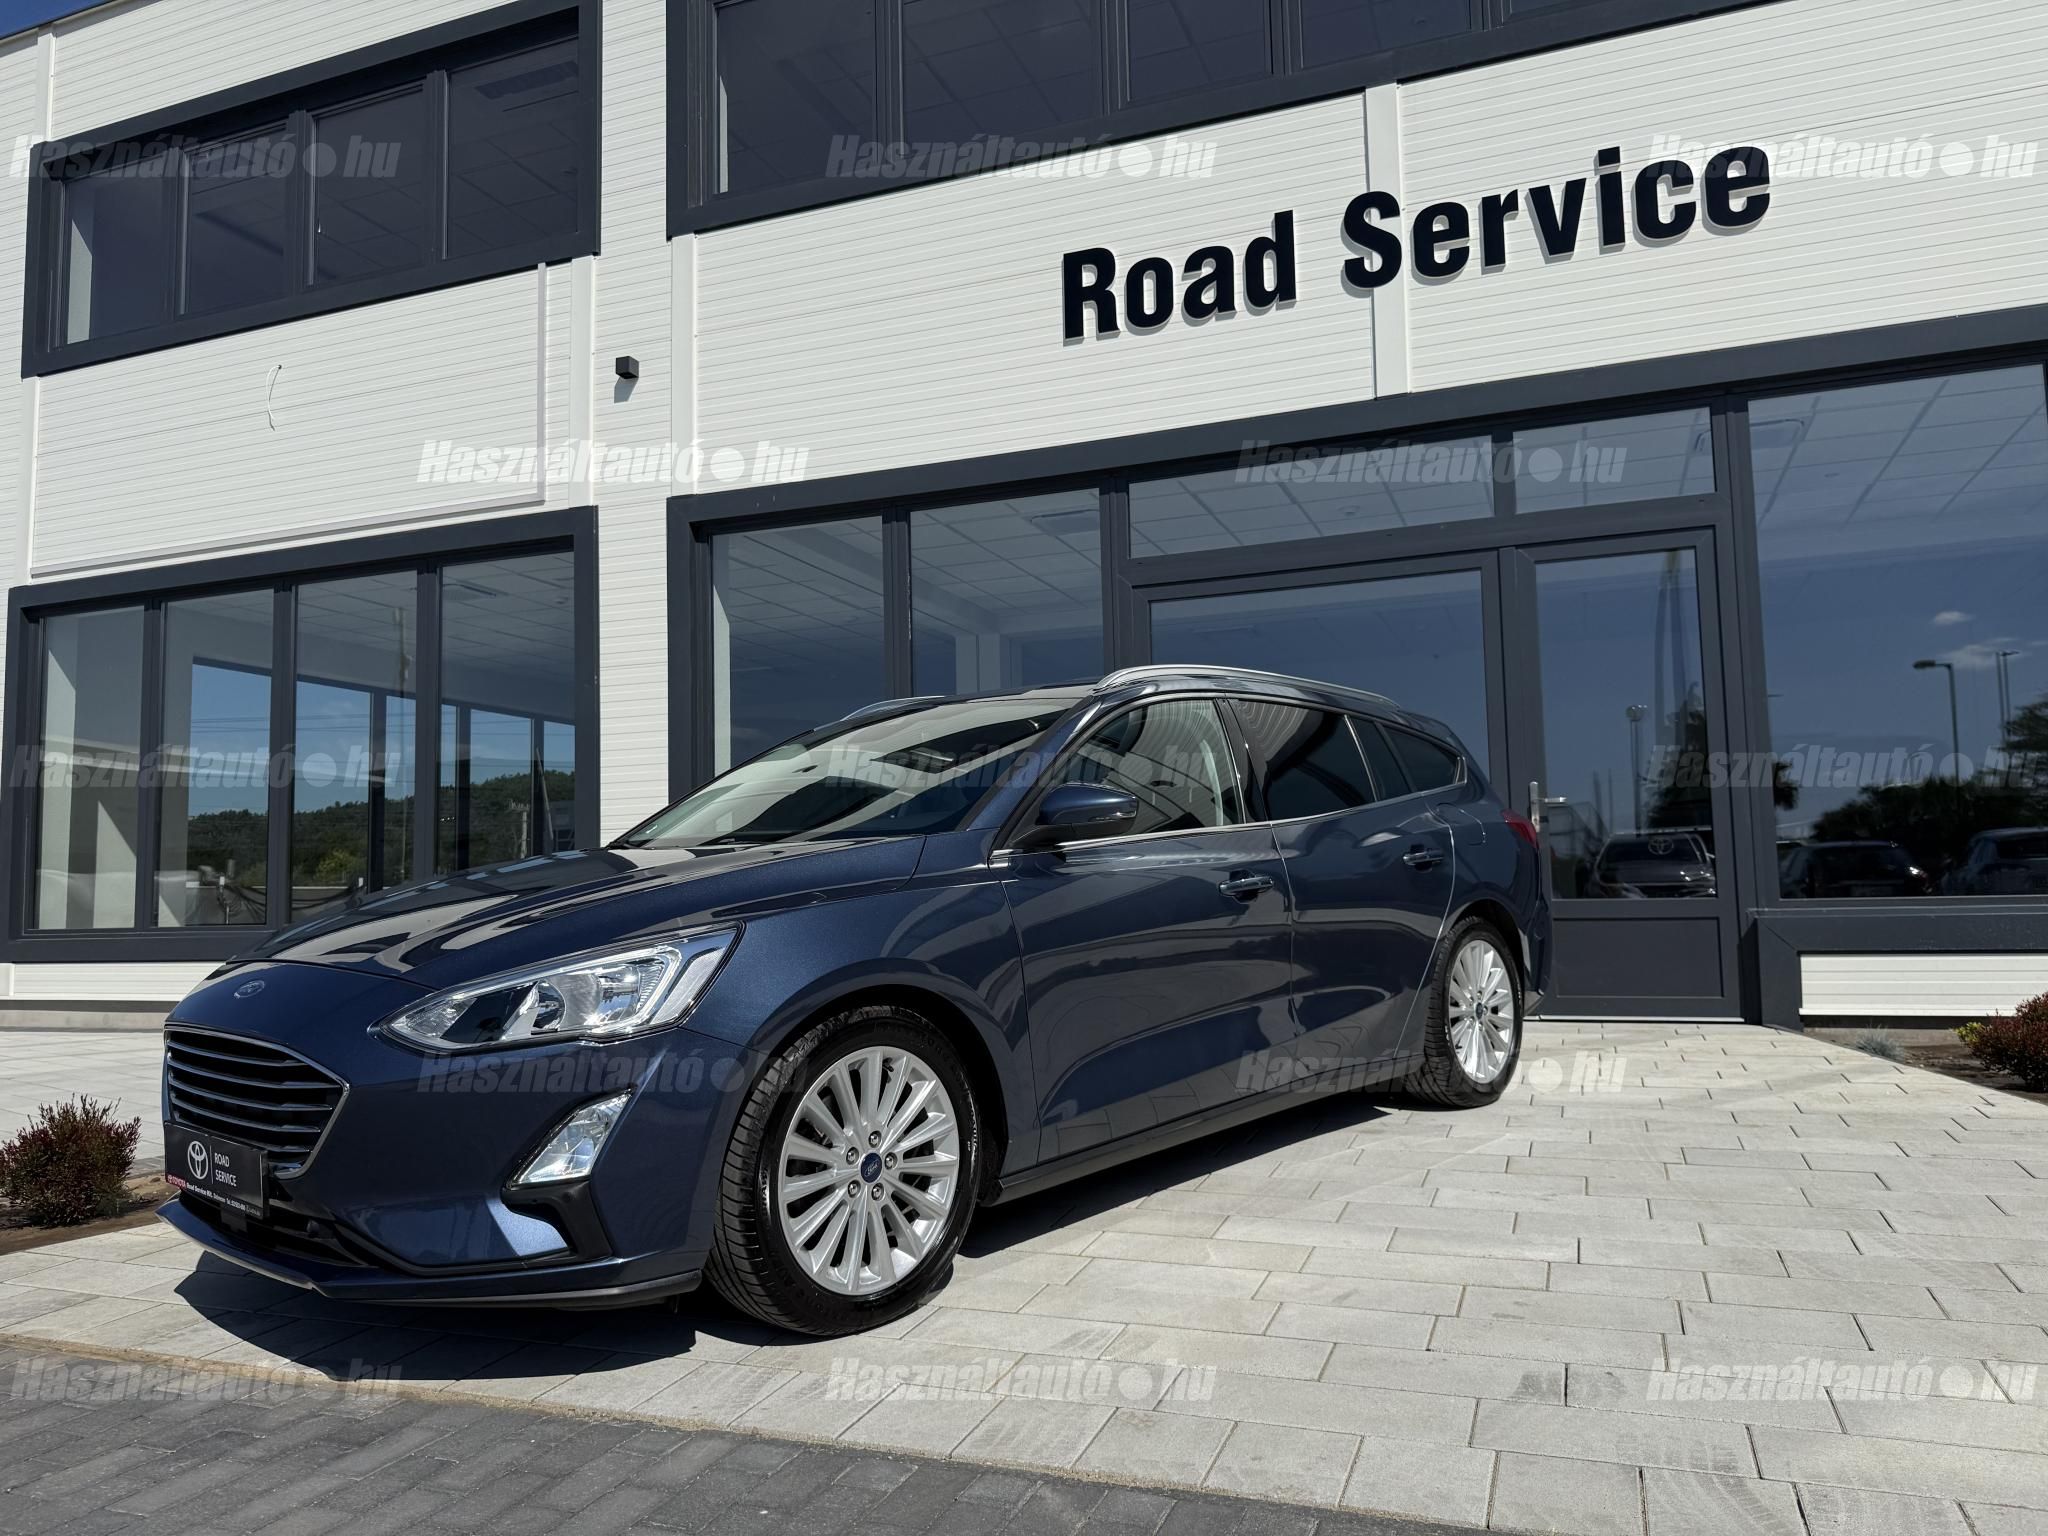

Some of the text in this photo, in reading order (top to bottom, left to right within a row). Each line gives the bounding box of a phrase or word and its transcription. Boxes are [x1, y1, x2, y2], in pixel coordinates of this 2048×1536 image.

[1063, 145, 1771, 340] Road Service
[214, 1152, 229, 1167] ROAD
[215, 1169, 237, 1186] SERVICE
